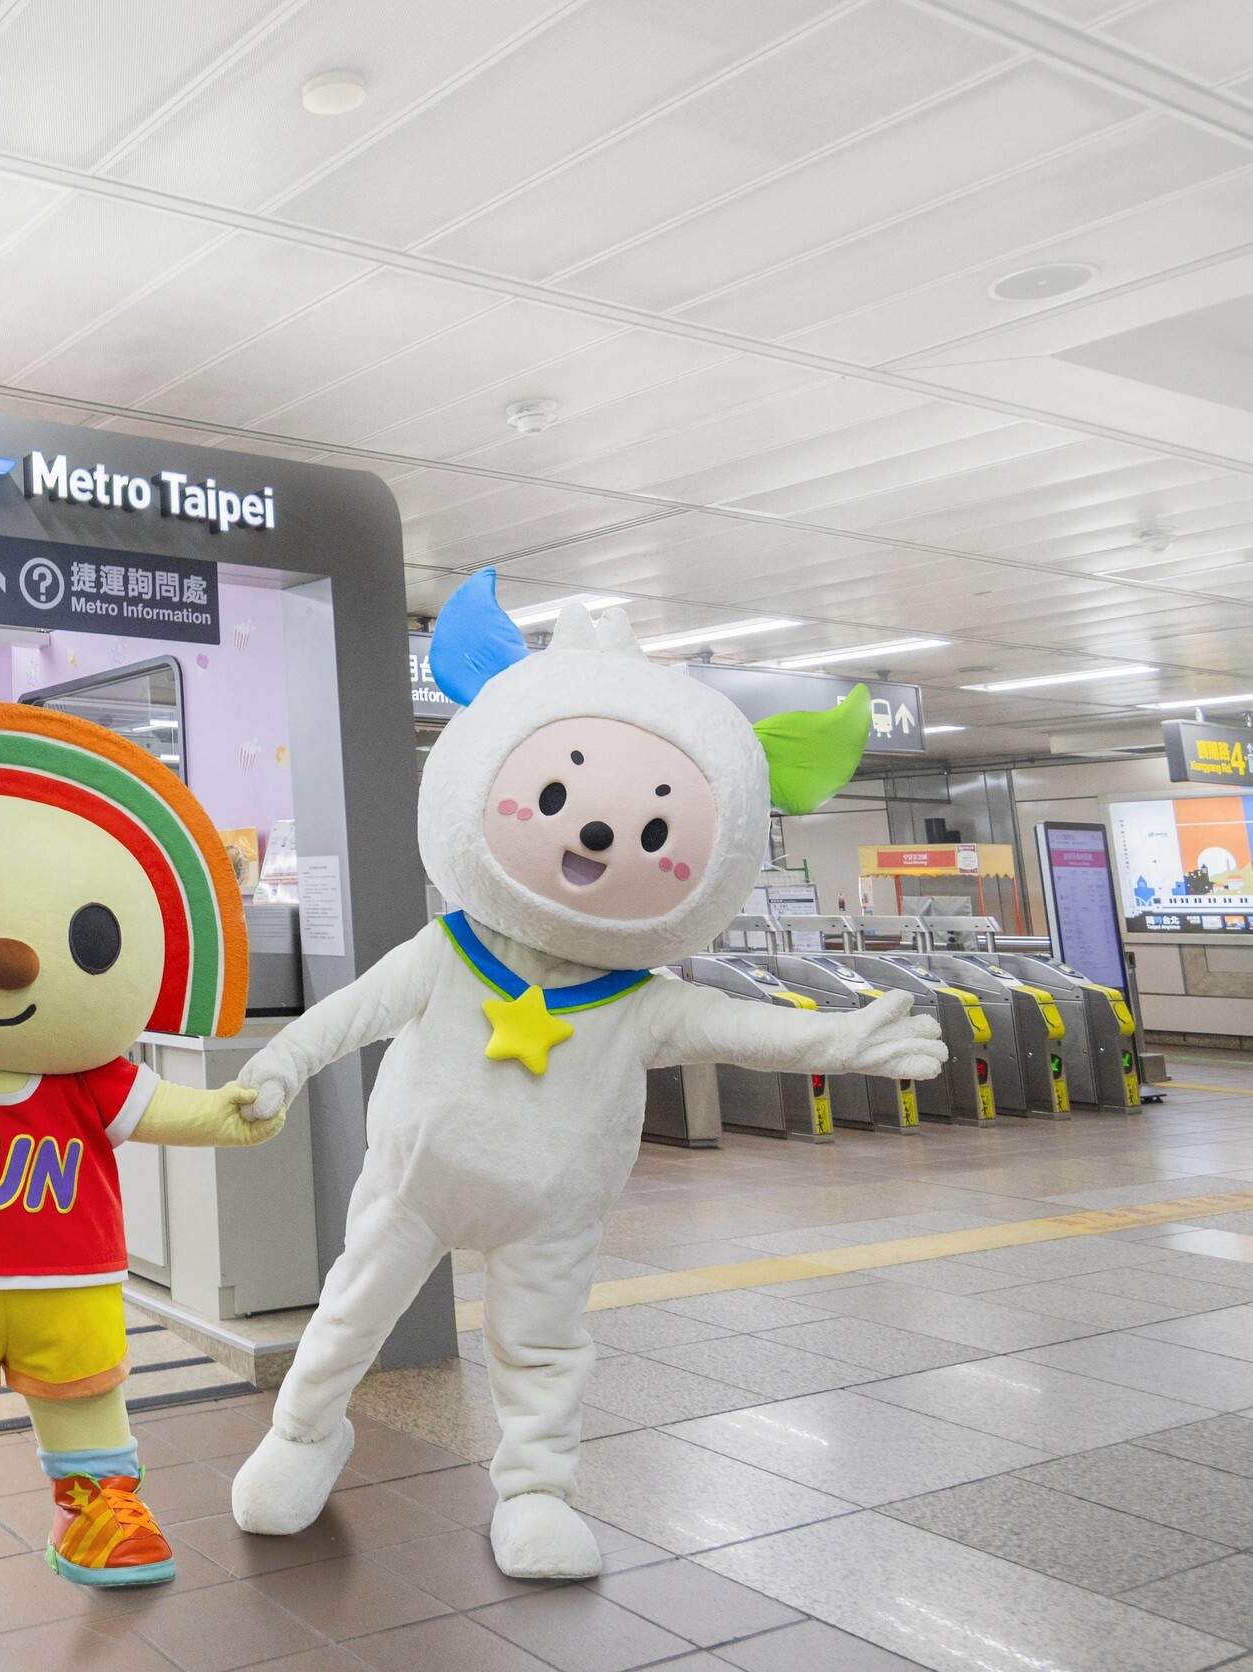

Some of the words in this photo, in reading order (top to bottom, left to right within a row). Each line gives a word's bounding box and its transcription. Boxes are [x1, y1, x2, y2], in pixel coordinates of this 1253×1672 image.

[32, 451, 151, 510] Metro
[161, 471, 275, 532] Taipei
[70, 561, 208, 605] 捷運詢問處
[71, 596, 118, 616] Metro
[123, 602, 211, 625] Information
[1231, 742, 1246, 775] 4
